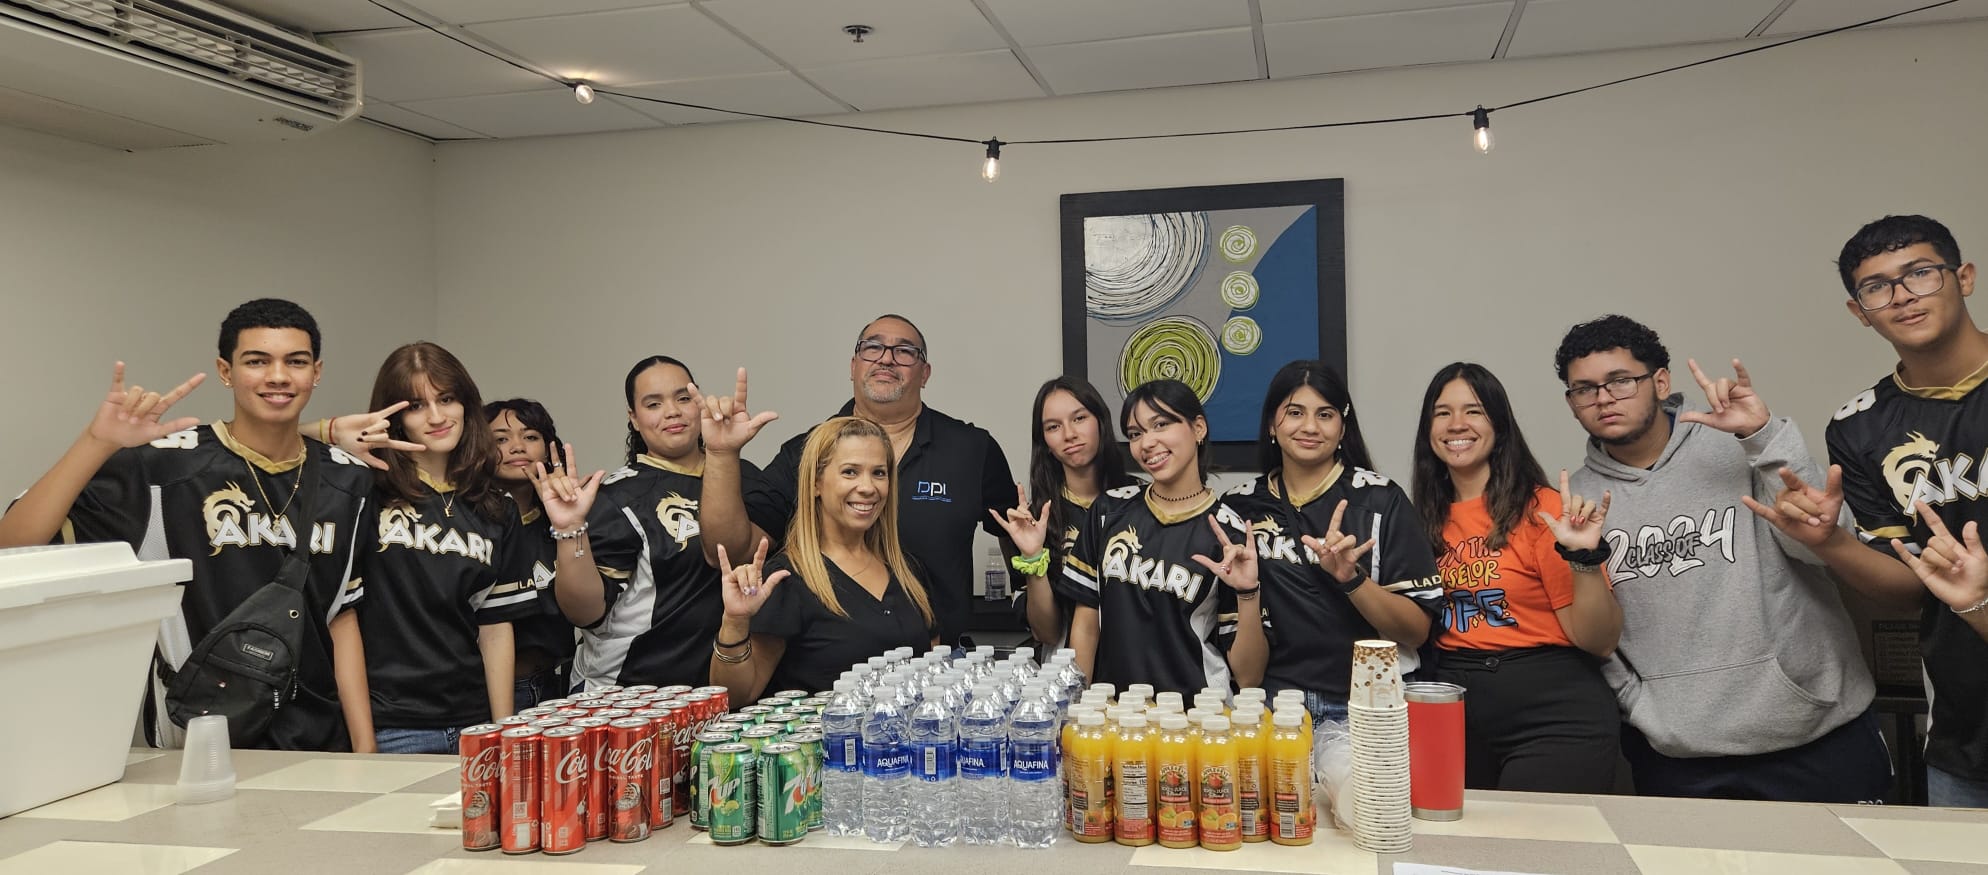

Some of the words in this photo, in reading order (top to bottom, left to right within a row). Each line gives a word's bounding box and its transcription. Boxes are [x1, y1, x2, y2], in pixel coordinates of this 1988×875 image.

[380, 519, 493, 566] AKARI
[1605, 506, 1736, 587] 2024
[1625, 540, 1674, 568] CLASS
[1674, 531, 1702, 558] OF
[1103, 550, 1203, 603] AKARI
[1013, 759, 1049, 770] AQUAFINA
